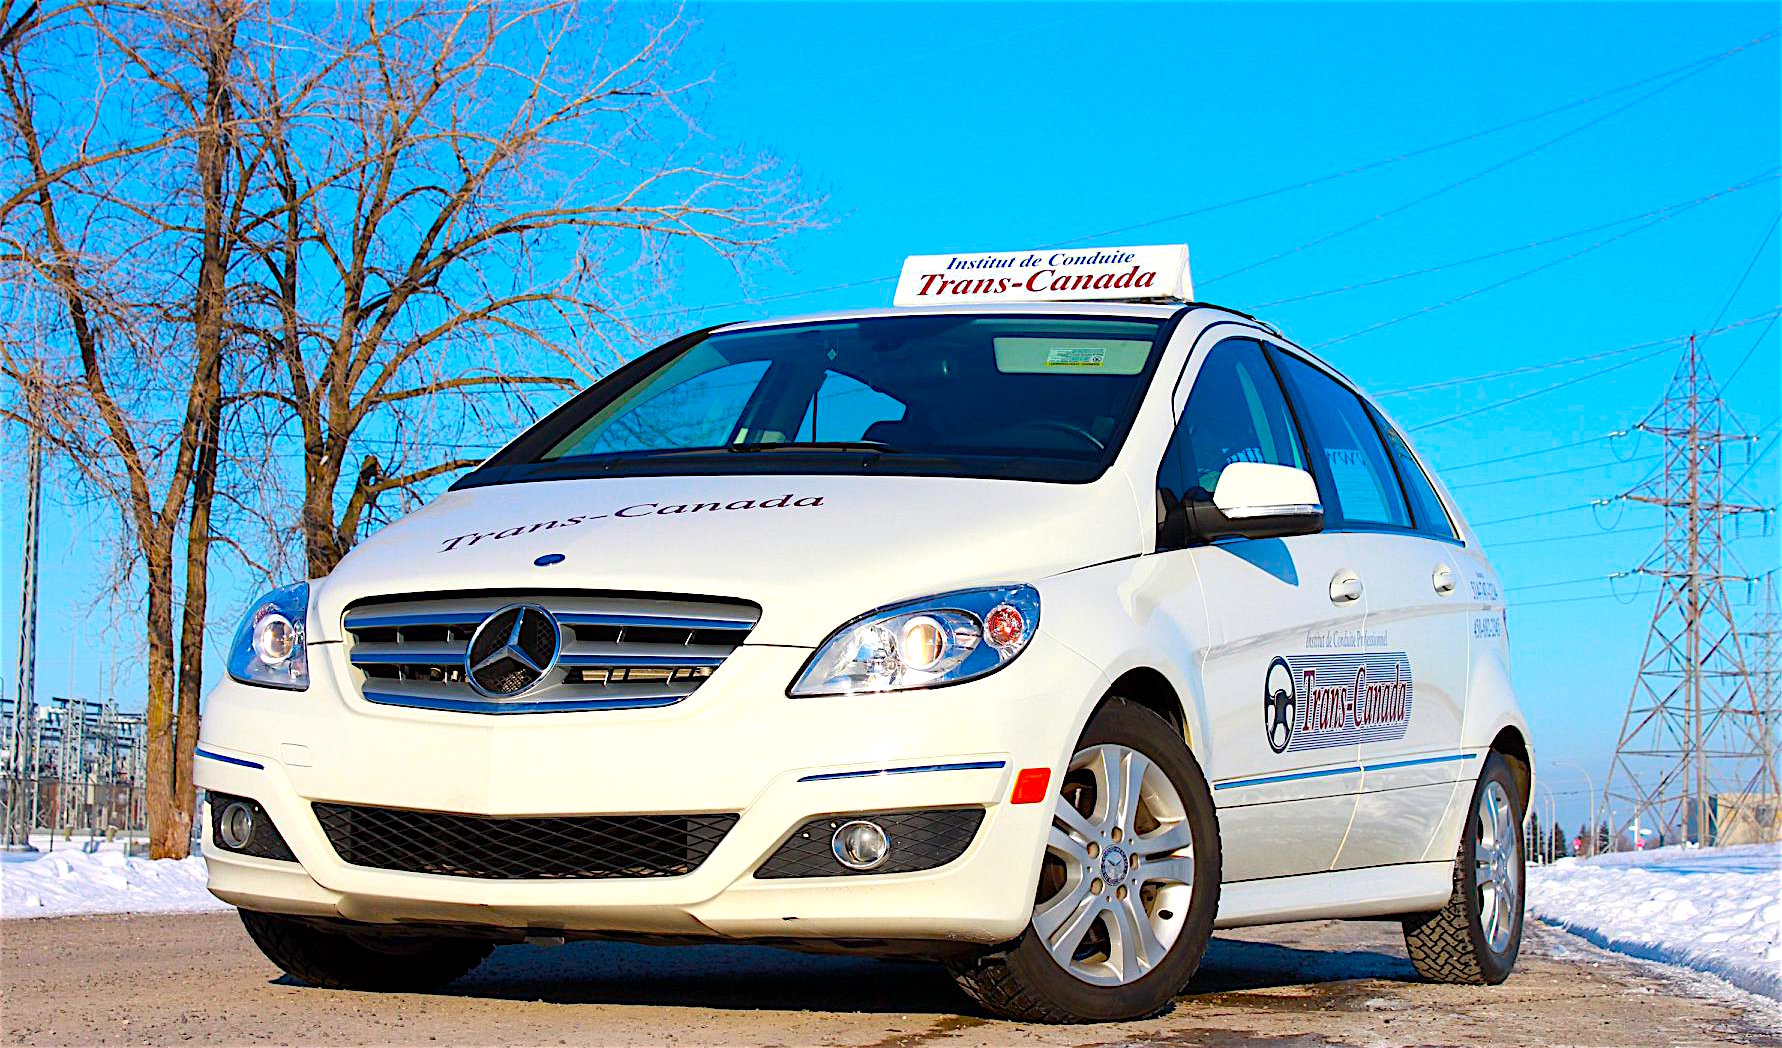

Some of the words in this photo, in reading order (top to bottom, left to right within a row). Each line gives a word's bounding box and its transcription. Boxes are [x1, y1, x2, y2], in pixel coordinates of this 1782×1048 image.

[916, 265, 1157, 296] Trans-Canada
[946, 256, 1016, 270] Institut
[1020, 254, 1042, 268] de
[1048, 250, 1136, 267] Conduite
[436, 494, 824, 553] Trans-Canada
[1302, 664, 1407, 731] Trans-Canada
